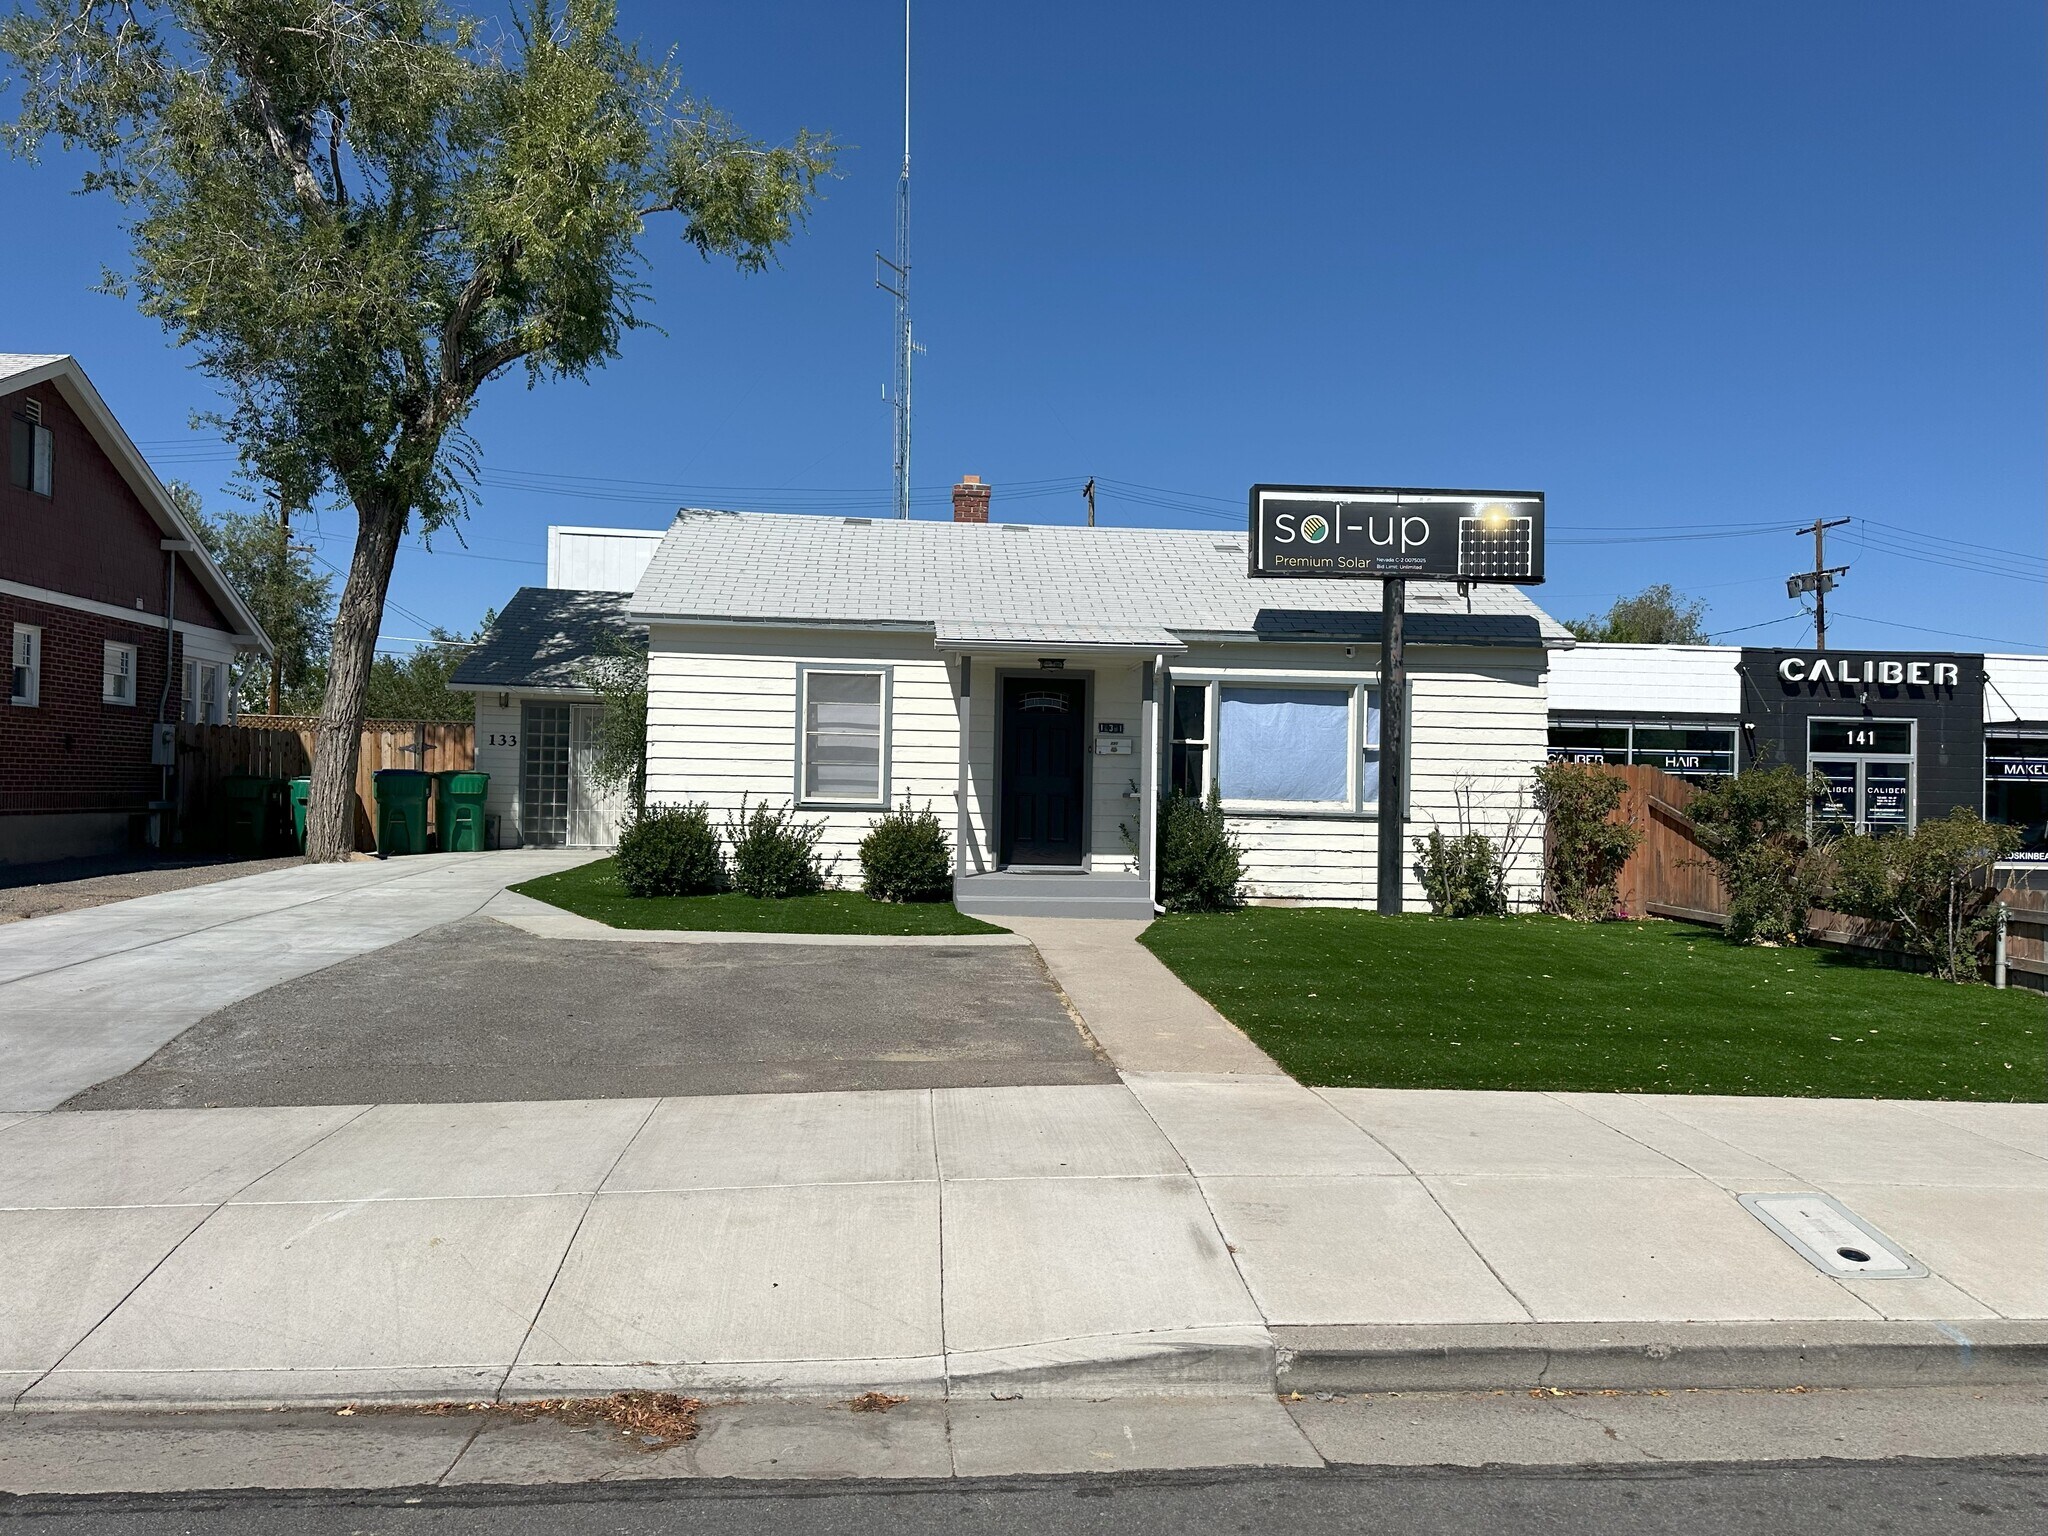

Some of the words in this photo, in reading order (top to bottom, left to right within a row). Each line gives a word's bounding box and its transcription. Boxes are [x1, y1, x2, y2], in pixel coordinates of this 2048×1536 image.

[1274, 504, 1430, 553] sol-up
[1275, 554, 1334, 567] Premium
[1337, 556, 1372, 568] Solar
[1779, 657, 1959, 686] CALIBER
[1100, 724, 1122, 732] 131
[488, 734, 517, 747] 133
[1846, 730, 1875, 746] 141
[1665, 756, 1699, 768] HAIR
